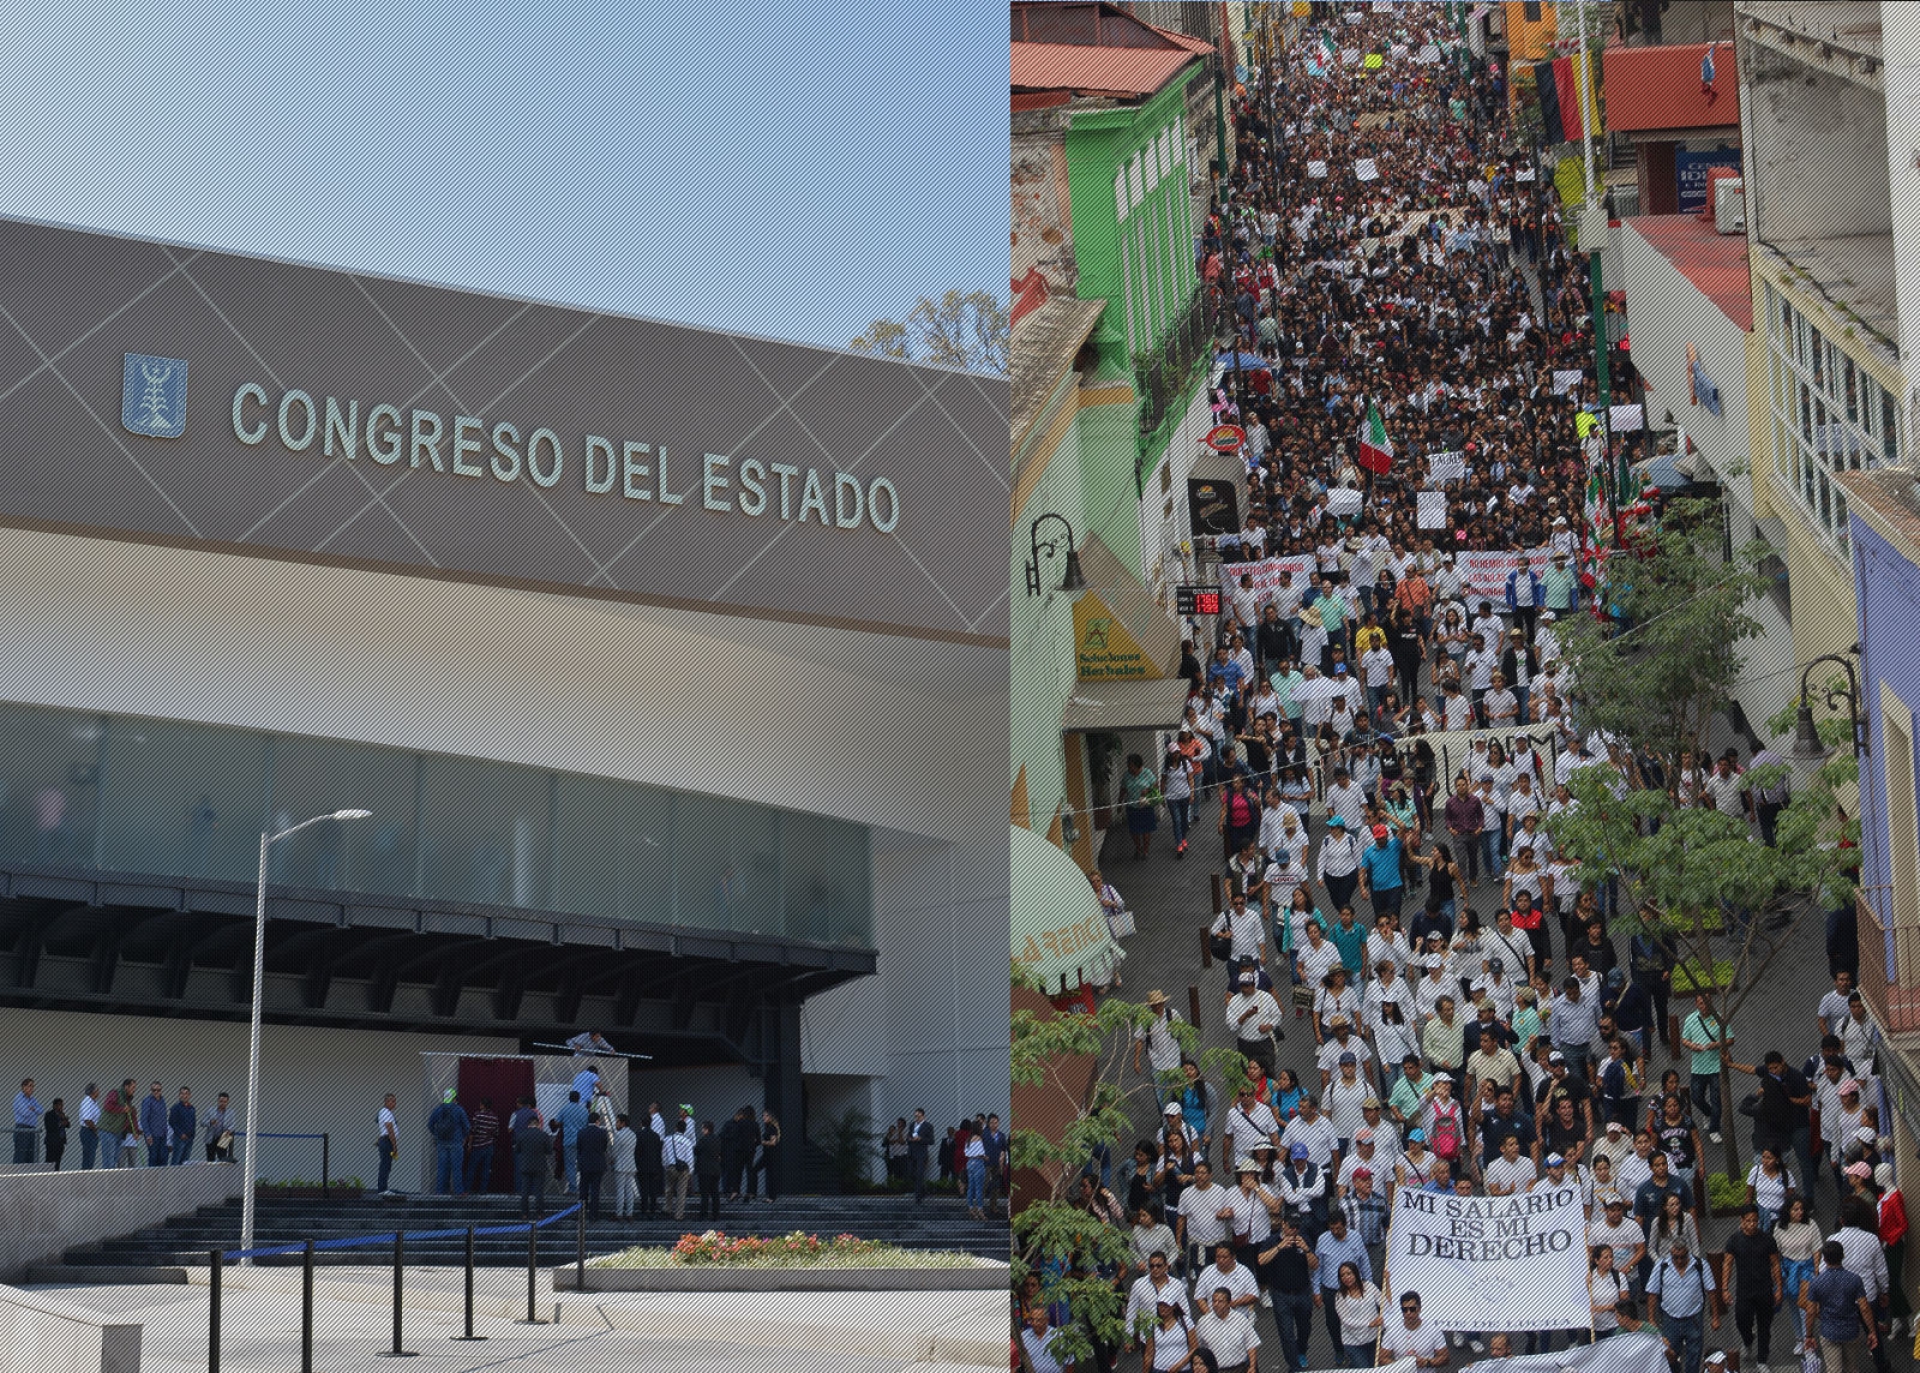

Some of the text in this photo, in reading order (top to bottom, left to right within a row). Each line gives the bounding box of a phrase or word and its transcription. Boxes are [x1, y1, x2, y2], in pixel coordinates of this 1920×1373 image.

[232, 382, 900, 534] CONGRESO DEL ESTADO
[1480, 558, 1505, 569] HEMOS
[1079, 652, 1141, 664] Soluciones
[1080, 664, 1146, 677] Herbales
[1403, 1188, 1574, 1219] MI SALARIO
[1449, 1217, 1531, 1239] ES MI
[1407, 1229, 1573, 1262] DERECHO
[1473, 1318, 1500, 1328] DE
